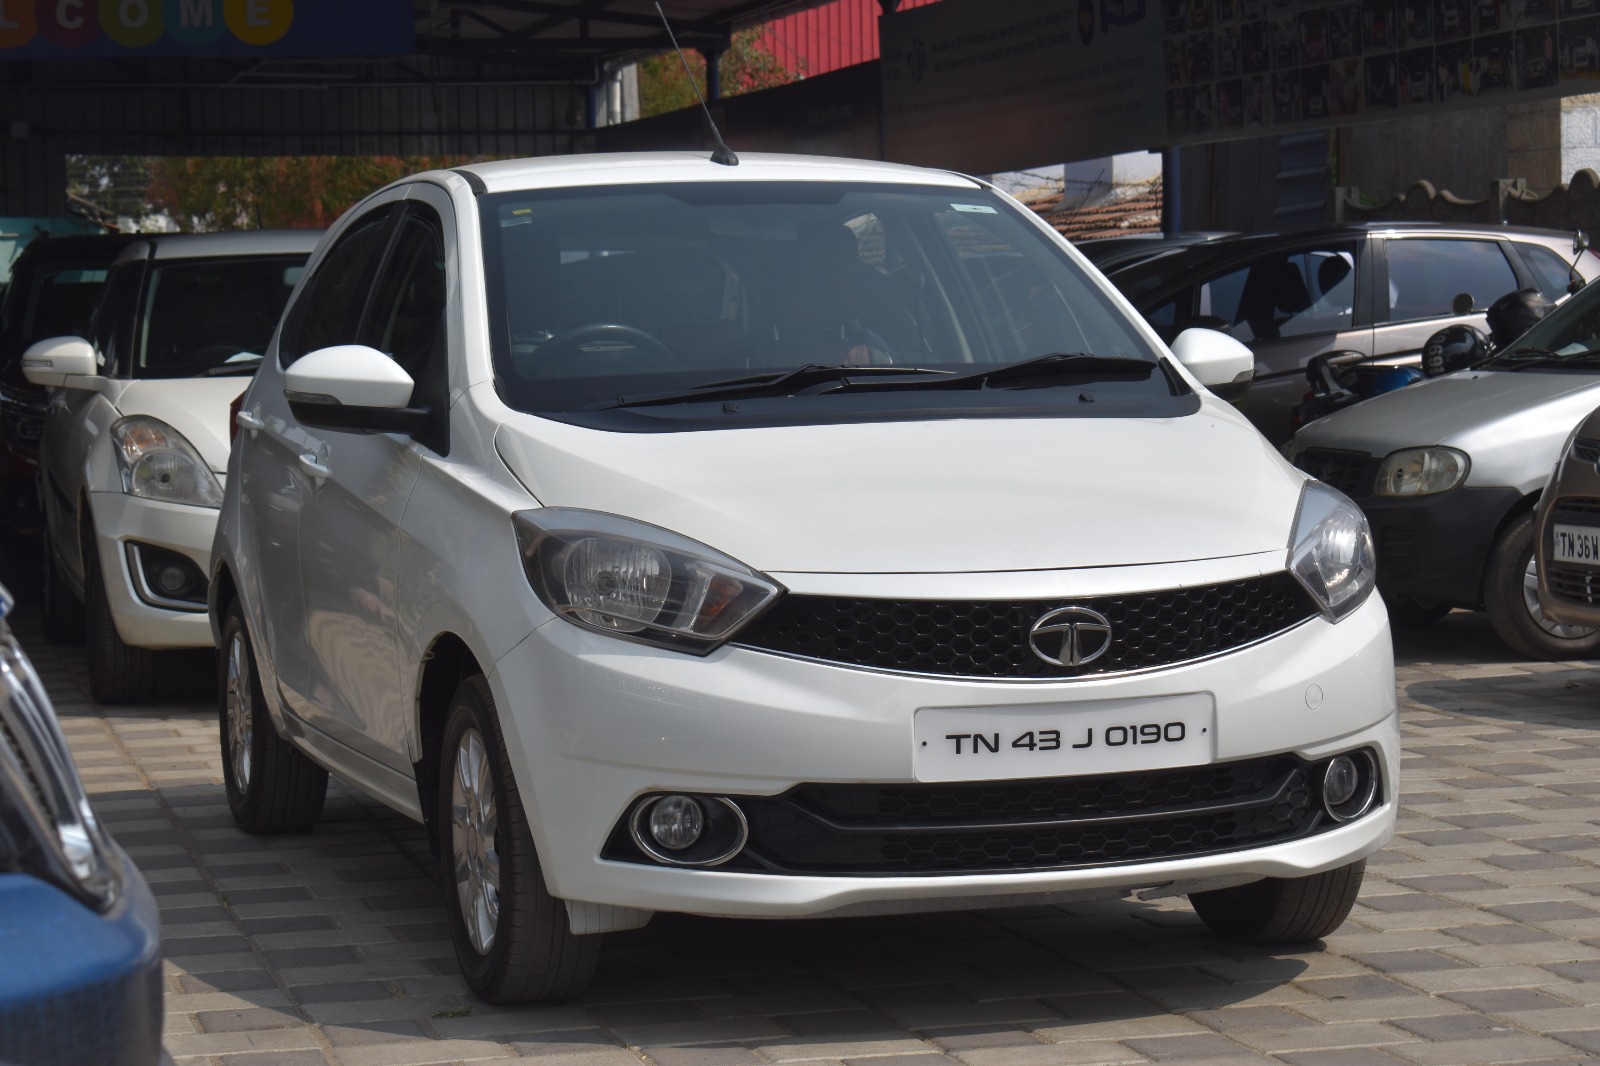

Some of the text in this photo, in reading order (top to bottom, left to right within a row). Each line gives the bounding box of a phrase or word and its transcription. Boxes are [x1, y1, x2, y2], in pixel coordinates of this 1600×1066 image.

[1560, 532, 1575, 557] TN
[946, 721, 1186, 754] TN 43 J 0190
